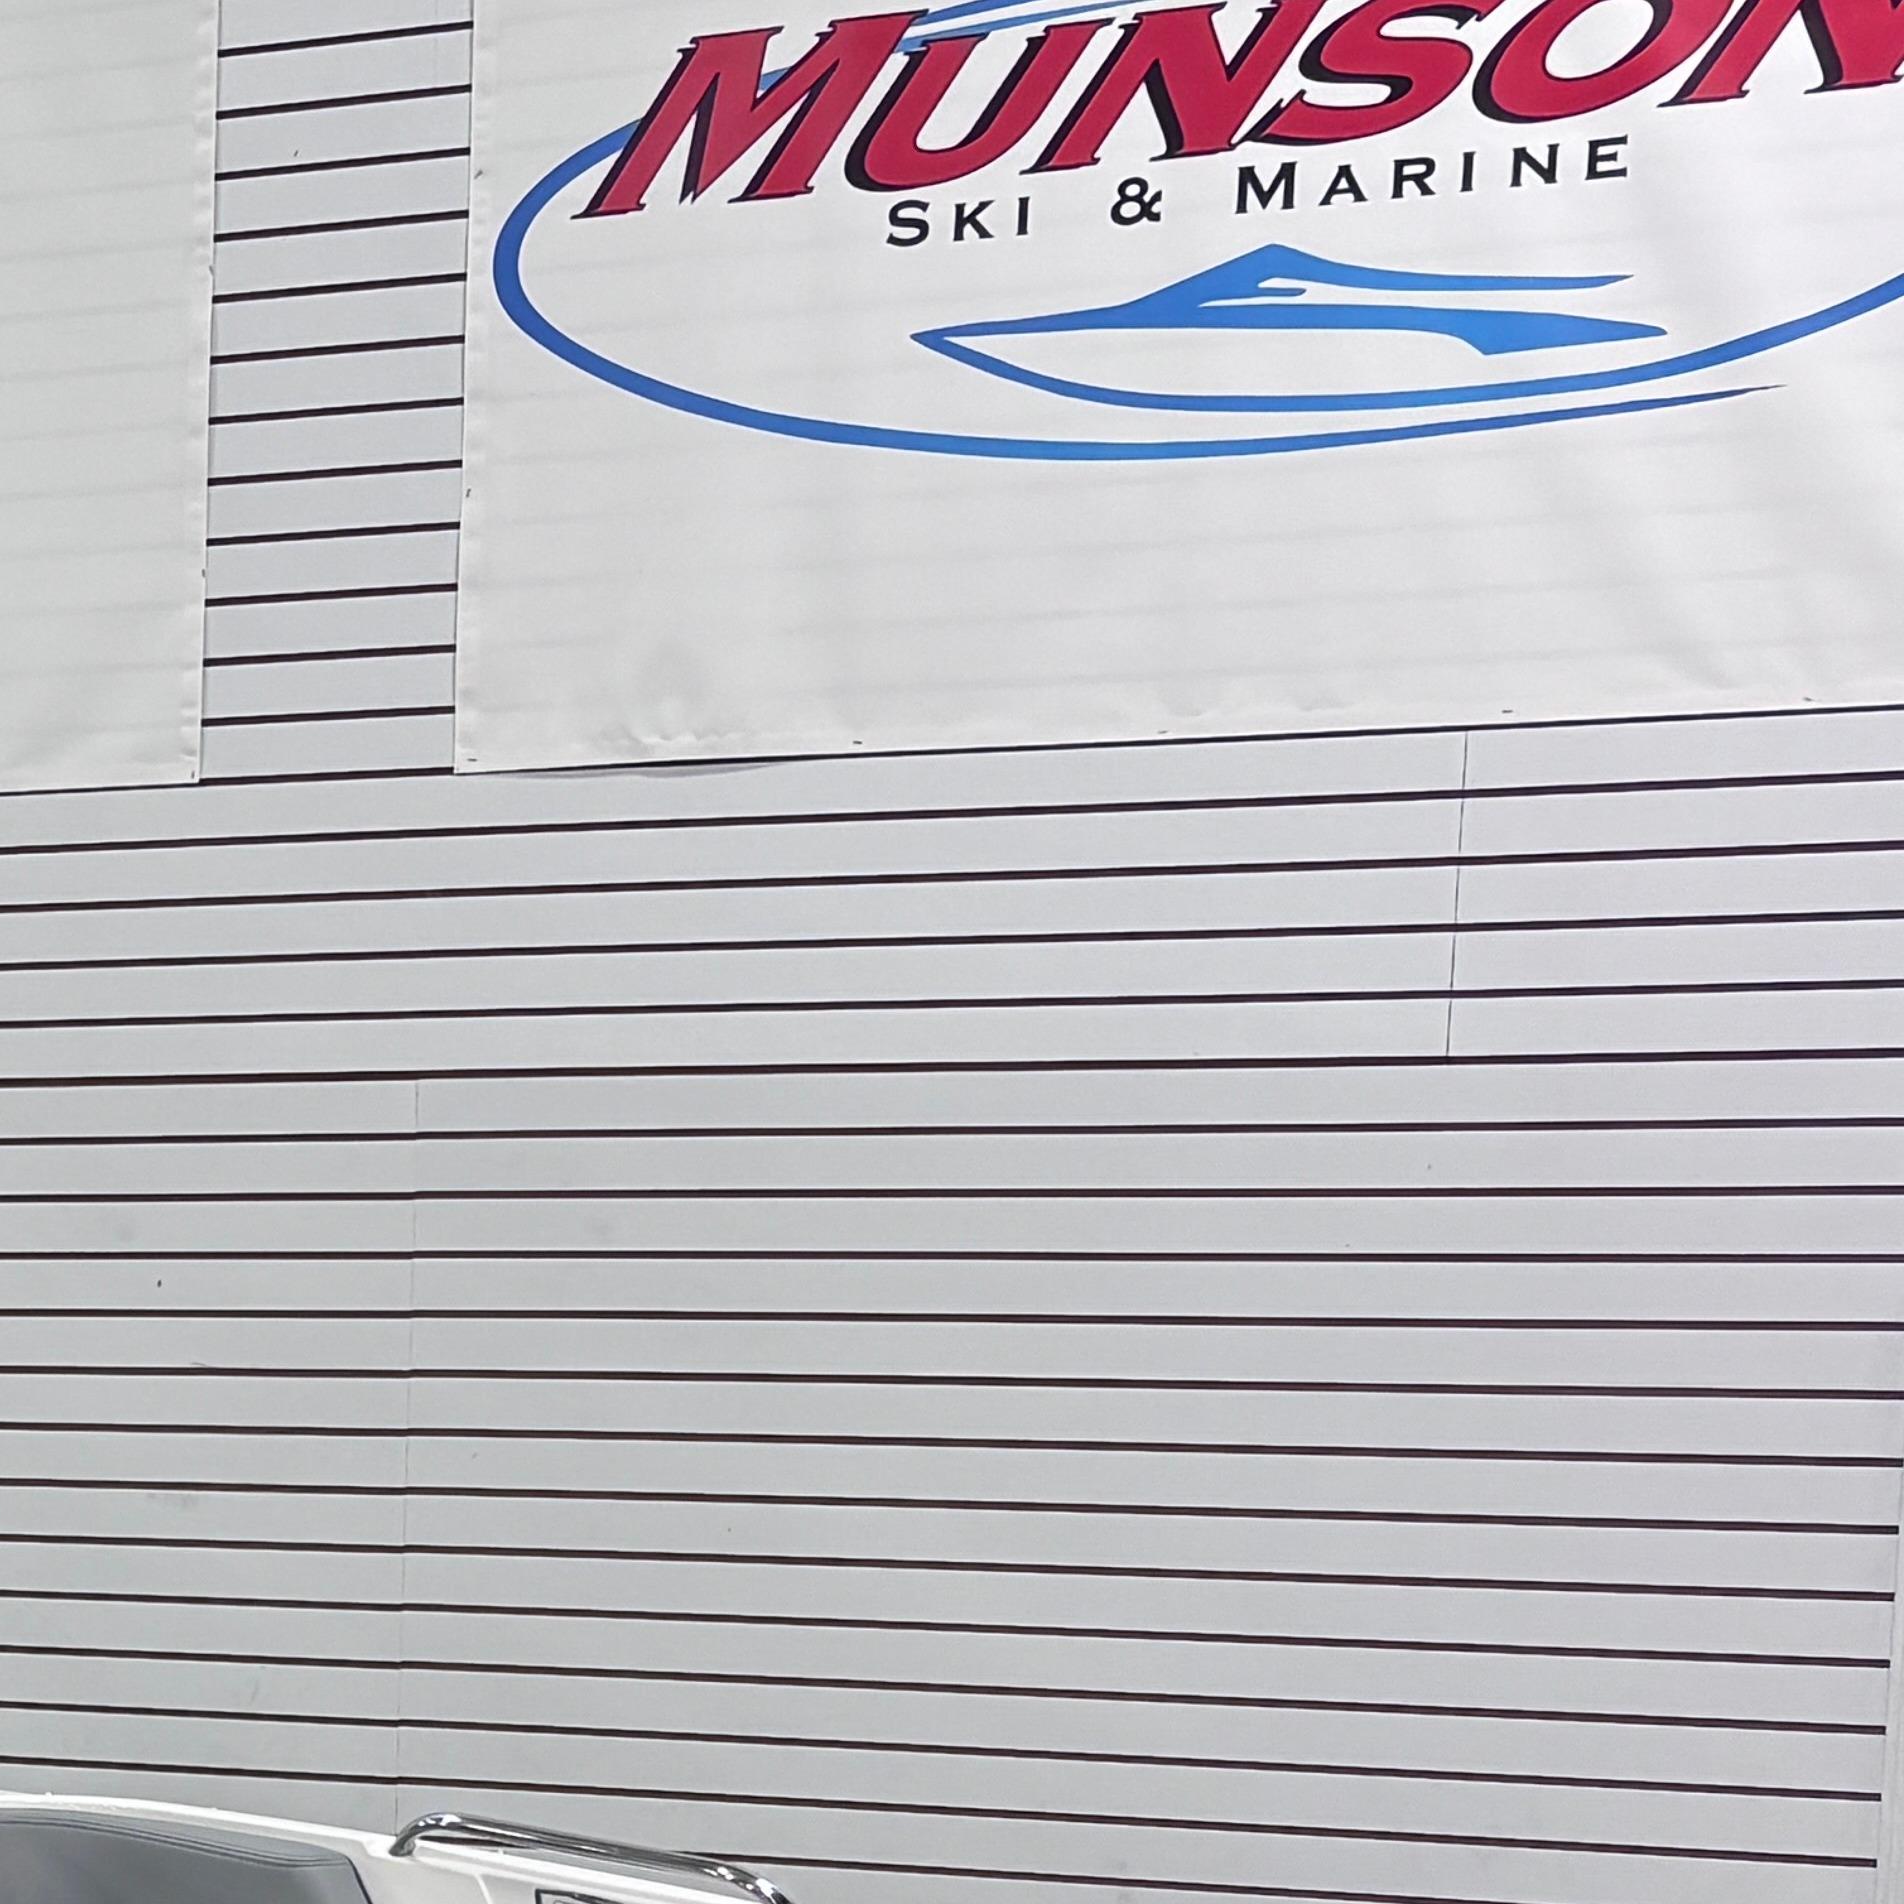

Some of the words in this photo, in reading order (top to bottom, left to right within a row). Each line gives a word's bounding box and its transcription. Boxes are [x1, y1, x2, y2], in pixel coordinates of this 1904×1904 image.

[572, 0, 1904, 220] MUNSON
[885, 196, 1031, 247] SKI
[1109, 177, 1163, 226] &
[1234, 134, 1629, 215] MARINE
